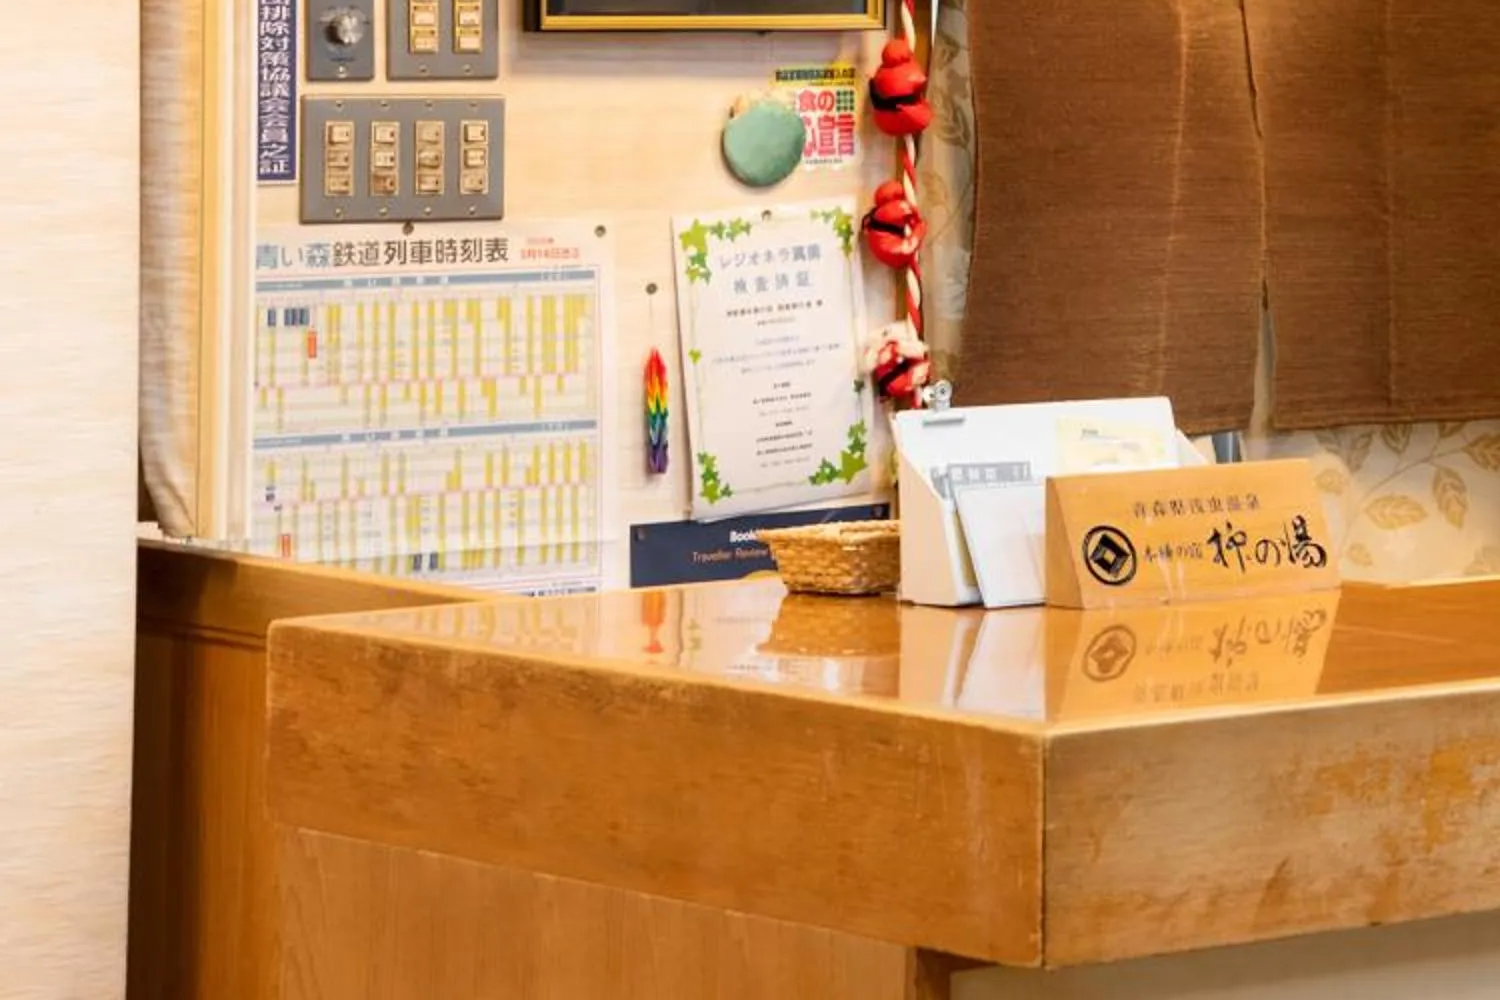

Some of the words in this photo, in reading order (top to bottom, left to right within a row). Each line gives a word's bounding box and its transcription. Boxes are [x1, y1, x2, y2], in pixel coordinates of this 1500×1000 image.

[256, 237, 508, 269] 青い森鉄道列車時刻表
